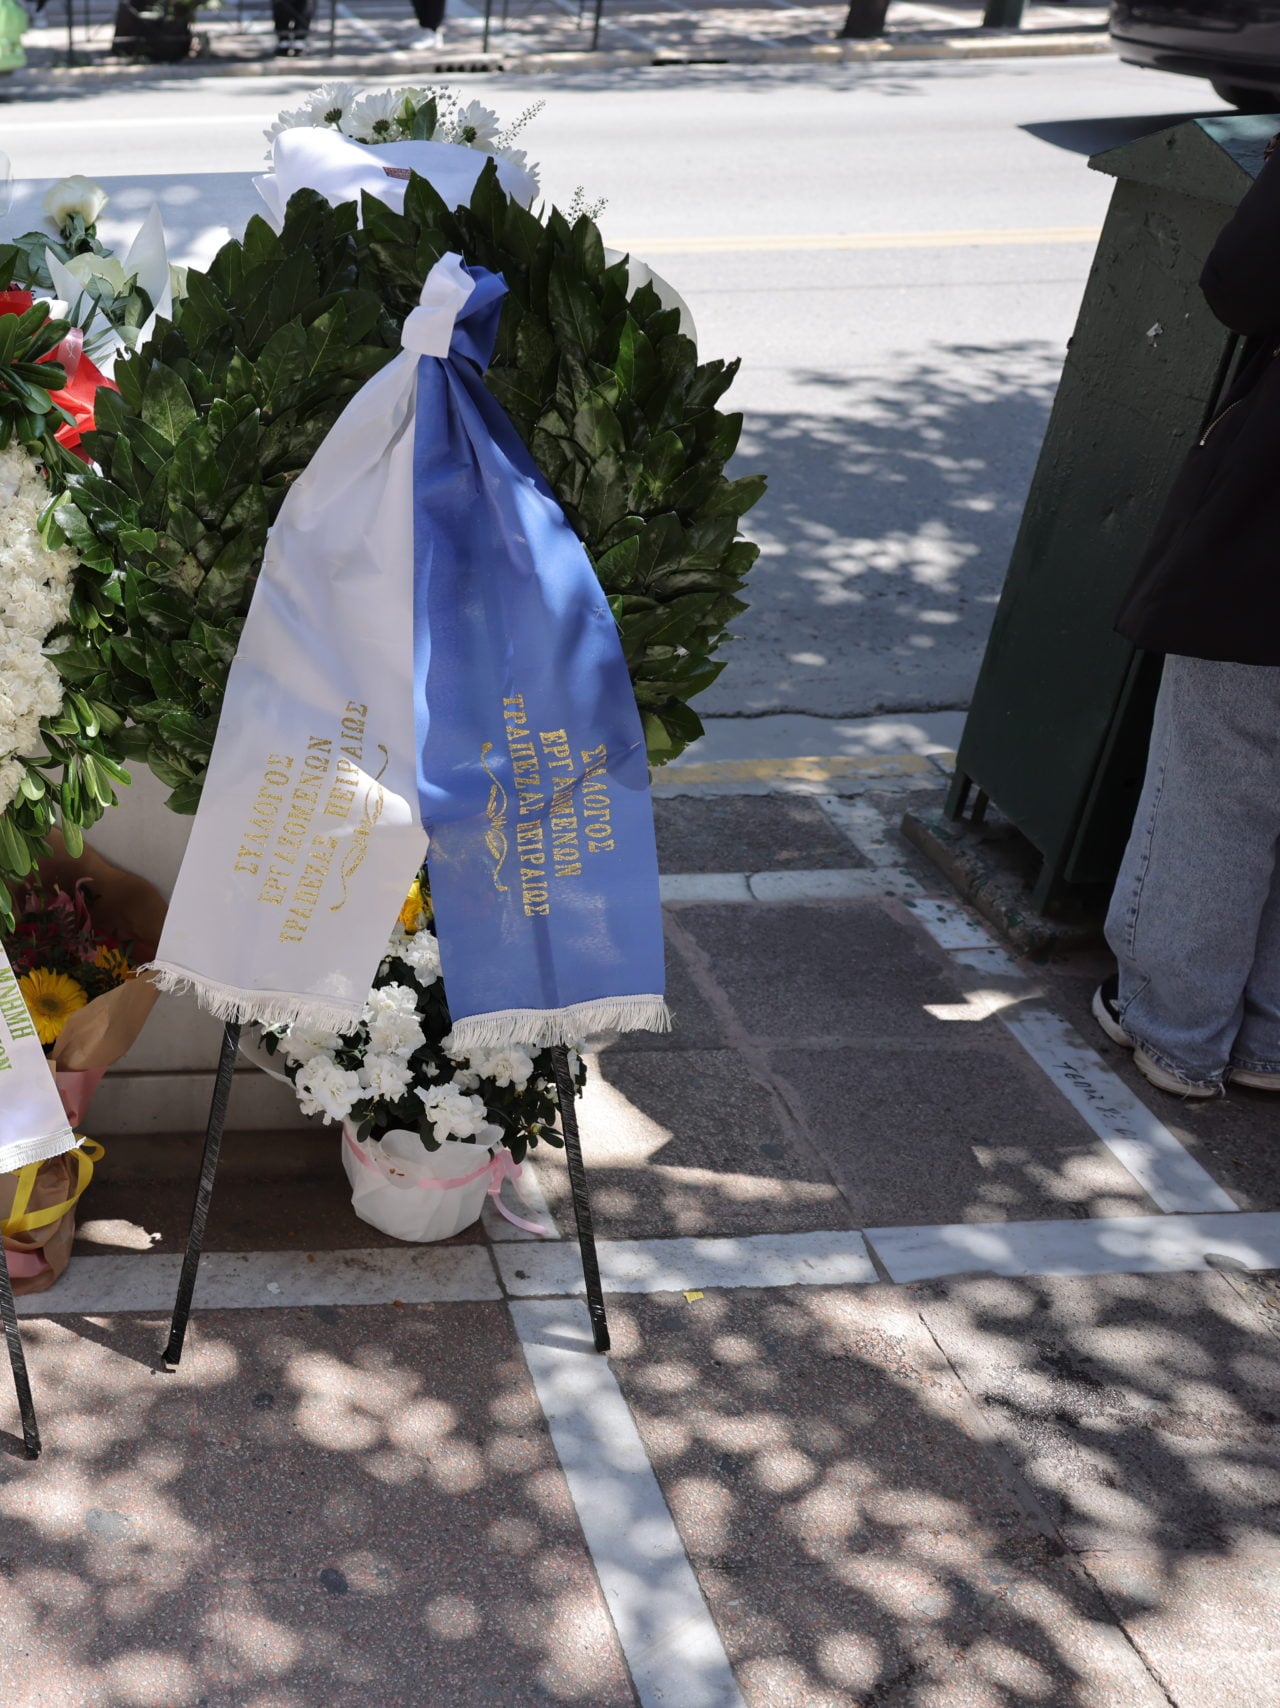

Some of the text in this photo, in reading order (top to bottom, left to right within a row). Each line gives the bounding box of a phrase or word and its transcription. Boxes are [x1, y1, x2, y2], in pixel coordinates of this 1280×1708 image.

[234, 753, 295, 876] ΣΥΛΛΟΓΟΣ
[257, 735, 333, 906] ΕΡΓΑΖΟΜΕΝΩΝ
[278, 700, 369, 944] ΤΡΑΠΕΖΑΣ ΠΕΙΡΑΙΩΣ
